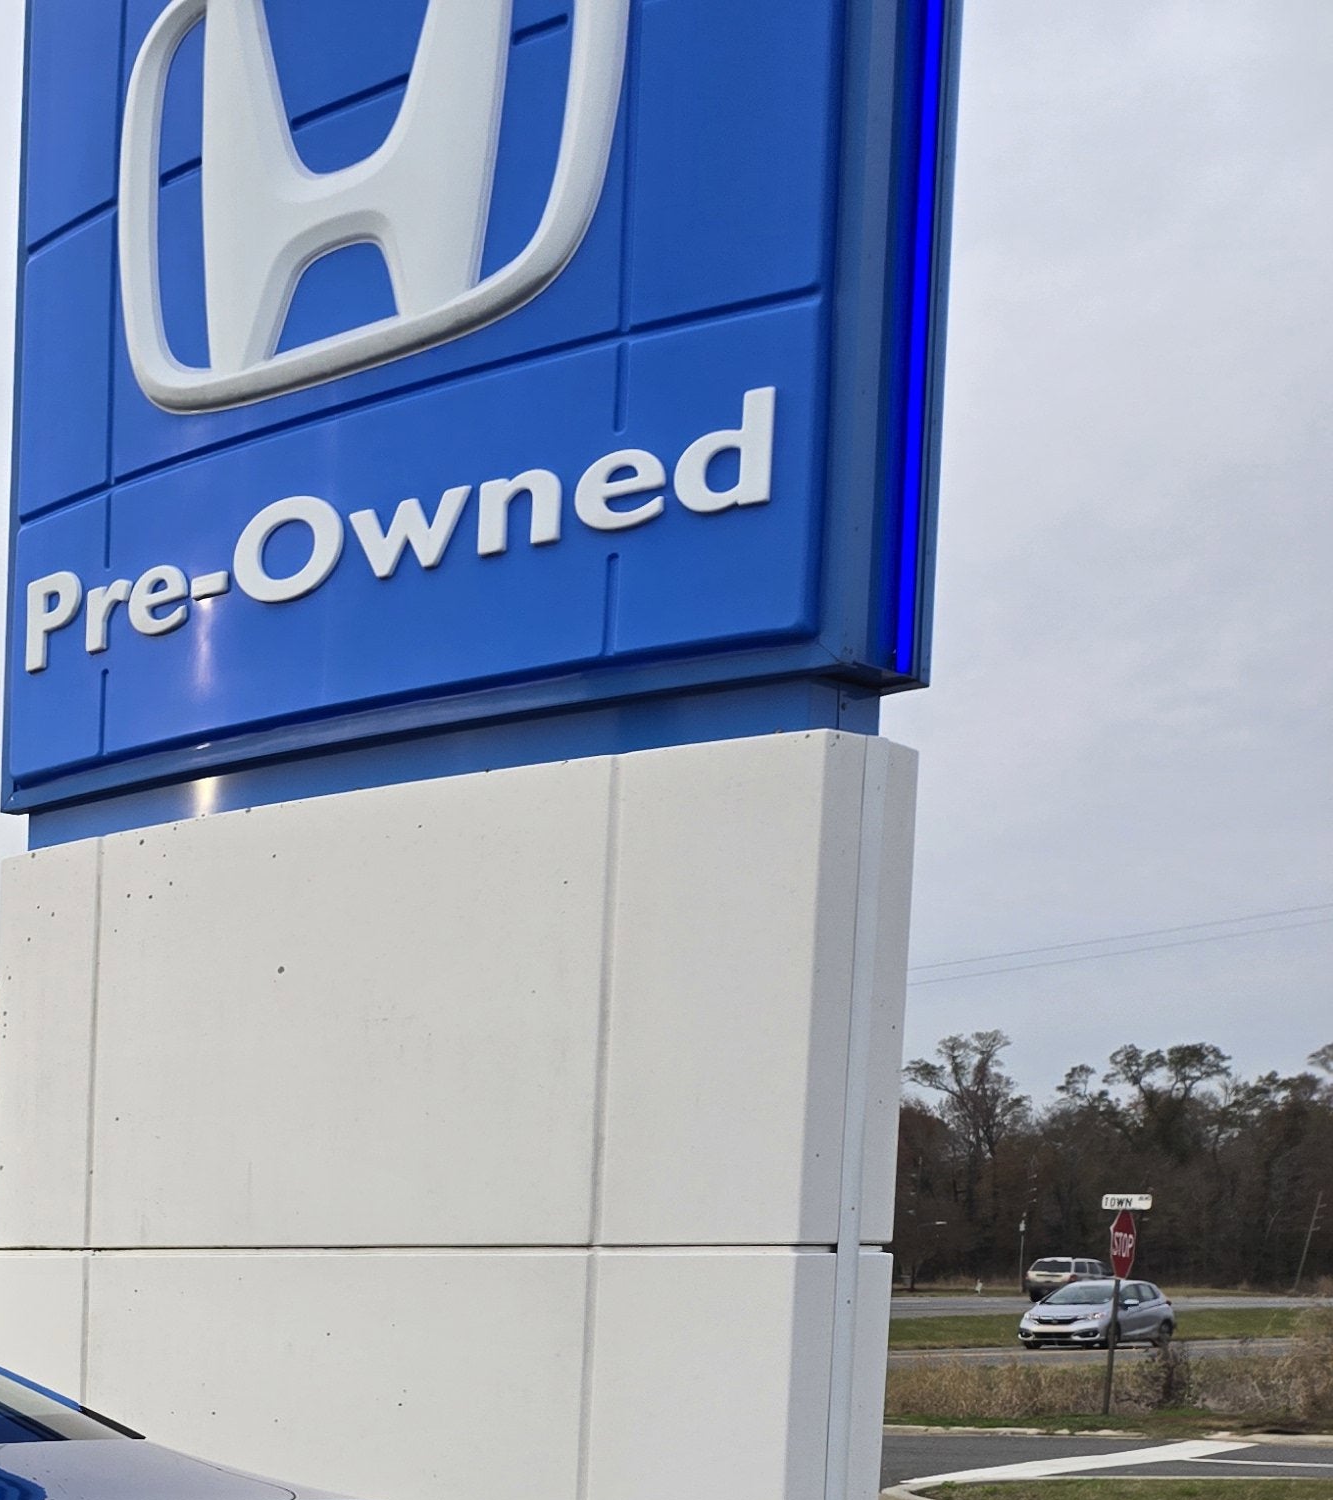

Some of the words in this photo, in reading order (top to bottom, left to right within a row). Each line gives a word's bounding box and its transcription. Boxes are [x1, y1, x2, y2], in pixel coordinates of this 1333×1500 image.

[24, 386, 775, 673] Pre-Owned
[1104, 1196, 1132, 1208] TOWN
[1113, 1231, 1134, 1258] STOP
